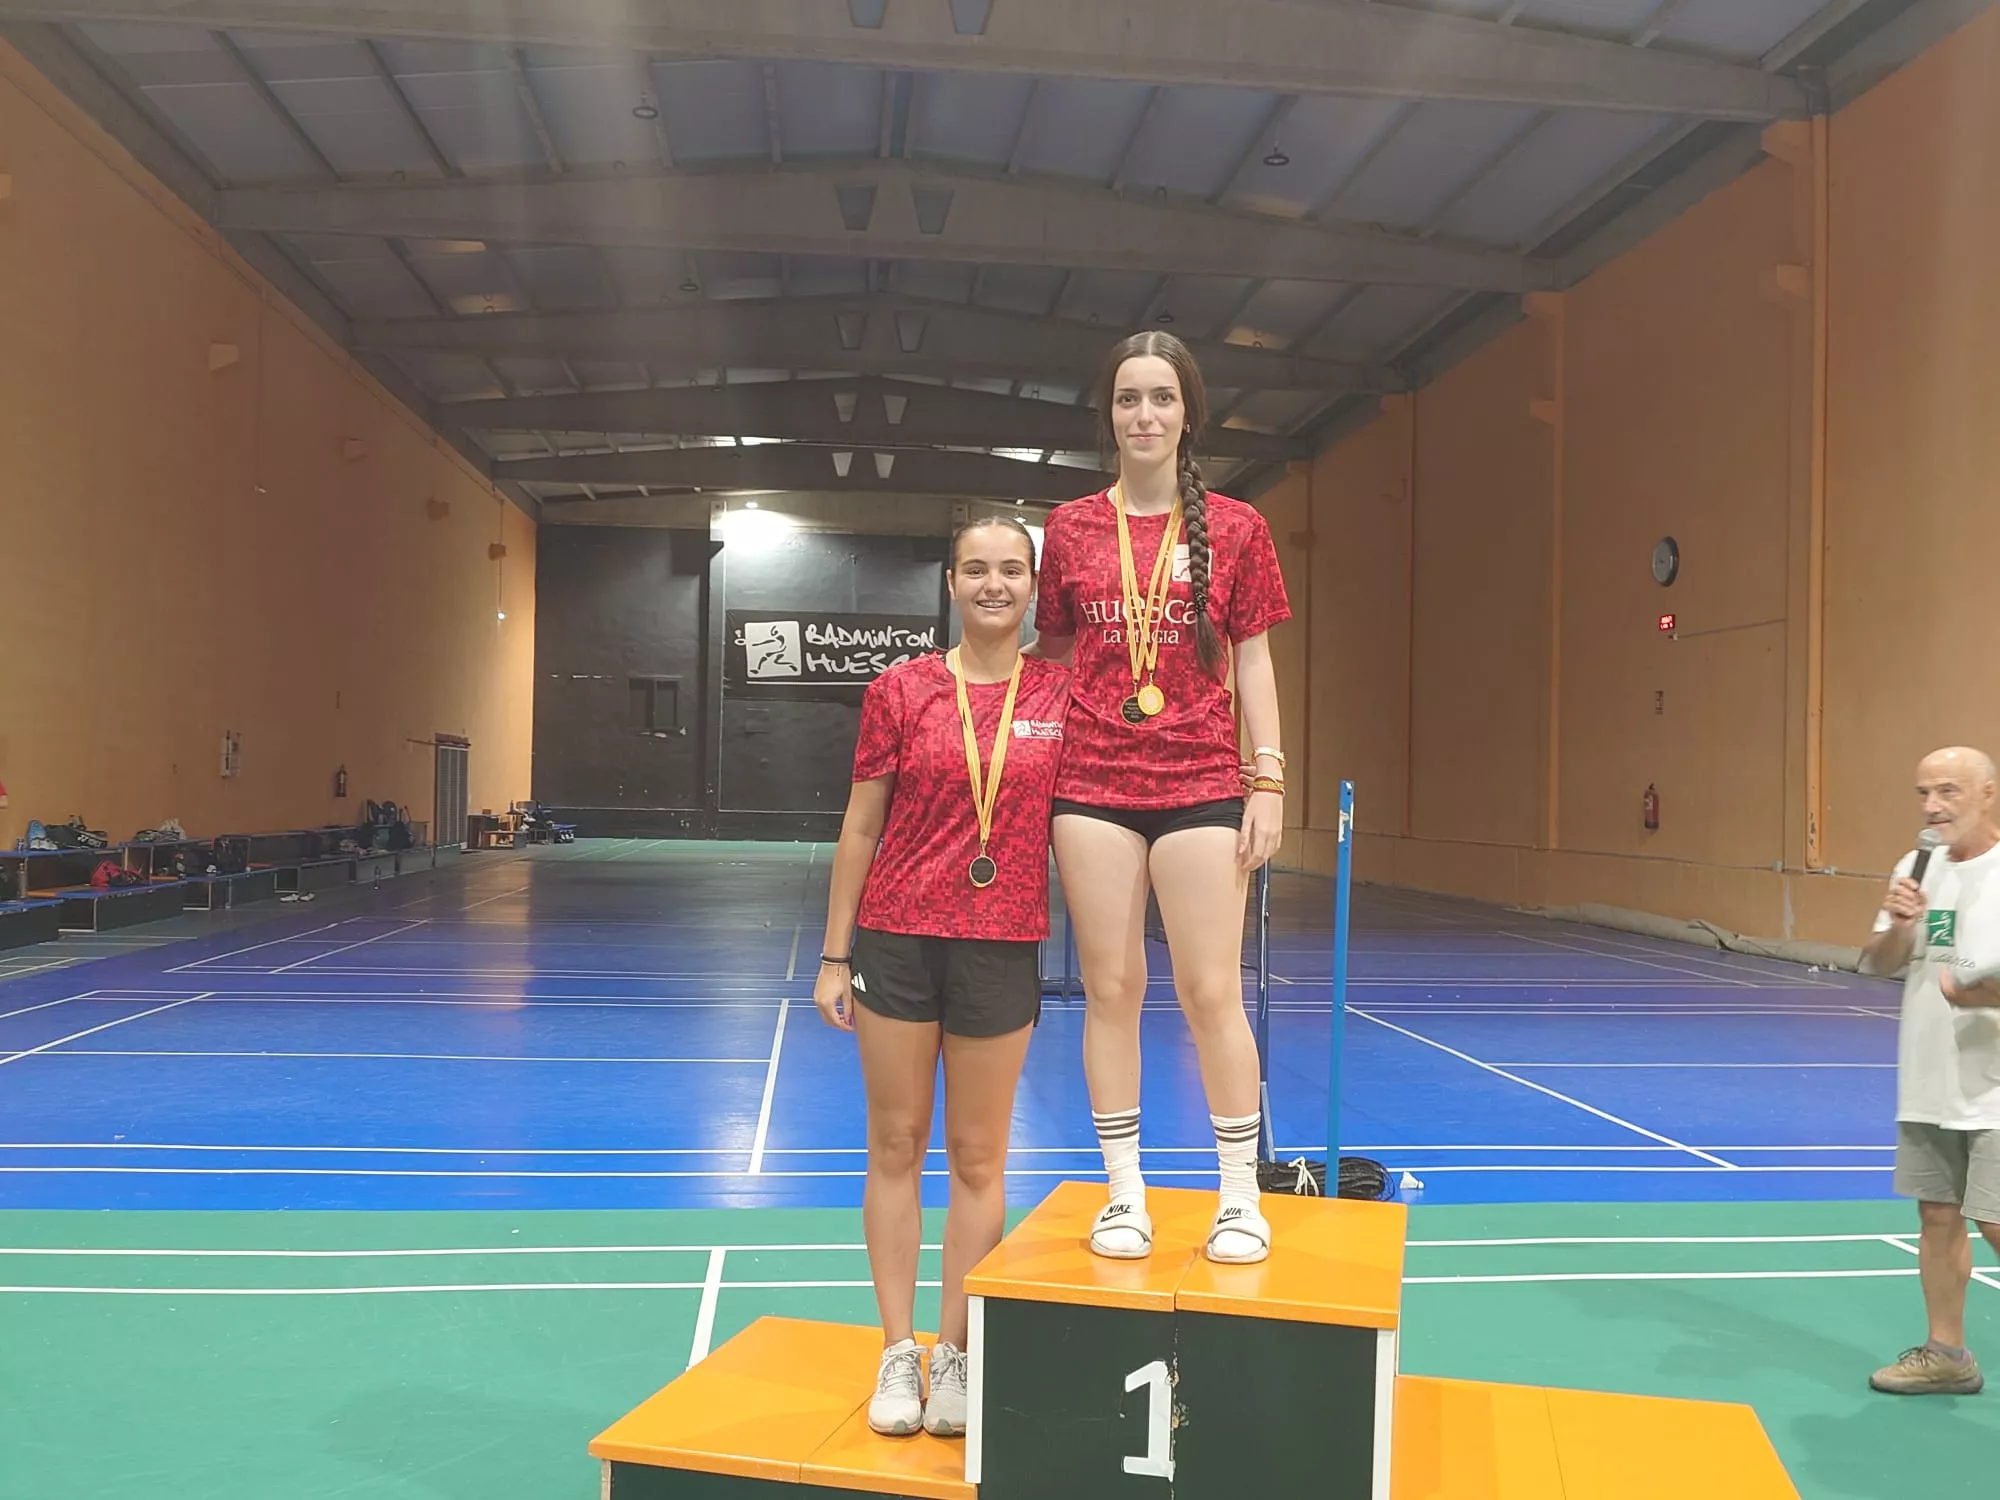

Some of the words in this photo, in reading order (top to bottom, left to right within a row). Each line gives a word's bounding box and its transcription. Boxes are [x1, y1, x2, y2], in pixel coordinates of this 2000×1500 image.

[806, 651, 925, 674] HUESC
[1106, 1204, 1133, 1216] NIKE
[1123, 1360, 1175, 1481] 1
